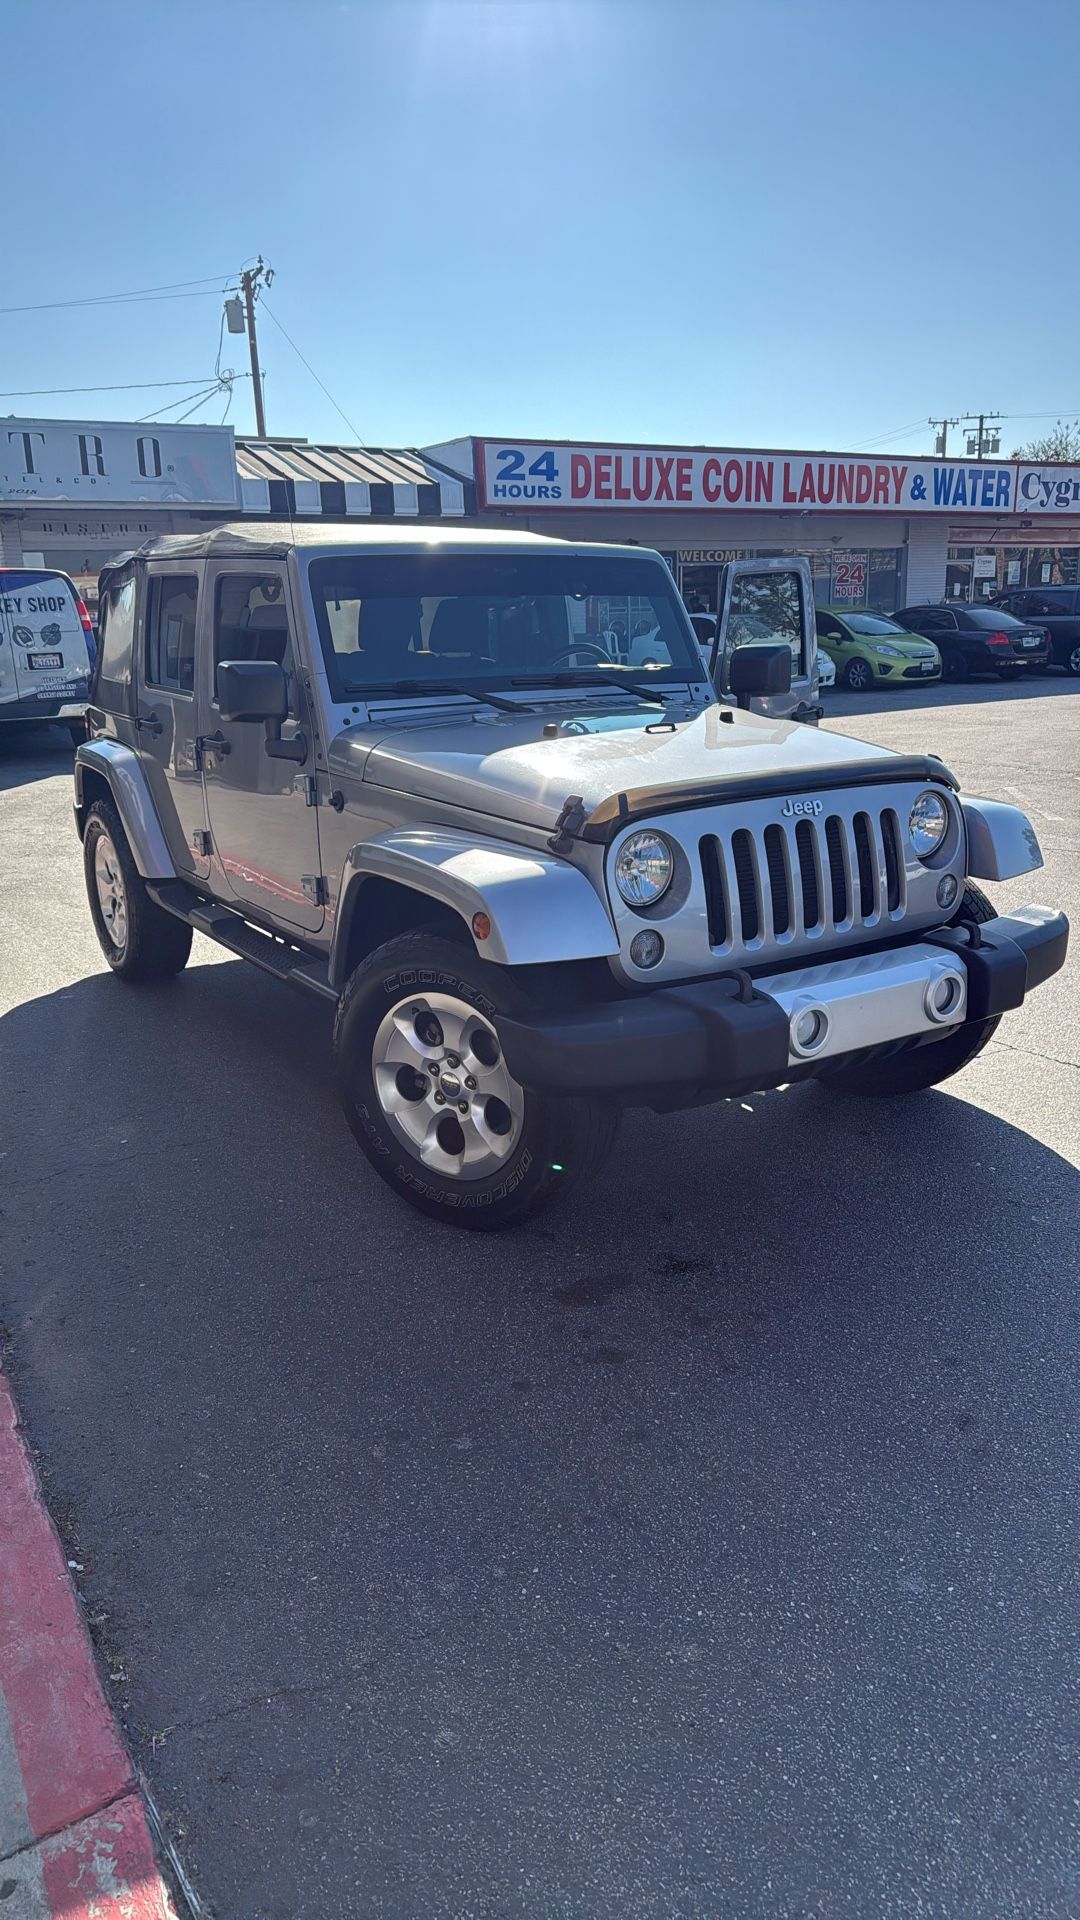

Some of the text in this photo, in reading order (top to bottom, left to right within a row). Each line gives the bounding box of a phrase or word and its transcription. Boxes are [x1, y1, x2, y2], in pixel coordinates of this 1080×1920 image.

[495, 450, 558, 482] 24
[570, 454, 1010, 507] DELUXE COIN LAUNDRY & WATER
[493, 484, 562, 499] HOURS
[680, 550, 743, 562] WELCOME
[836, 564, 865, 584] 24
[835, 586, 864, 598] HOURS
[27, 597, 66, 613] SHOP
[782, 799, 823, 817] Jeep
[384, 970, 497, 1016] COOPER
[395, 1148, 534, 1208] DISCOVERER
